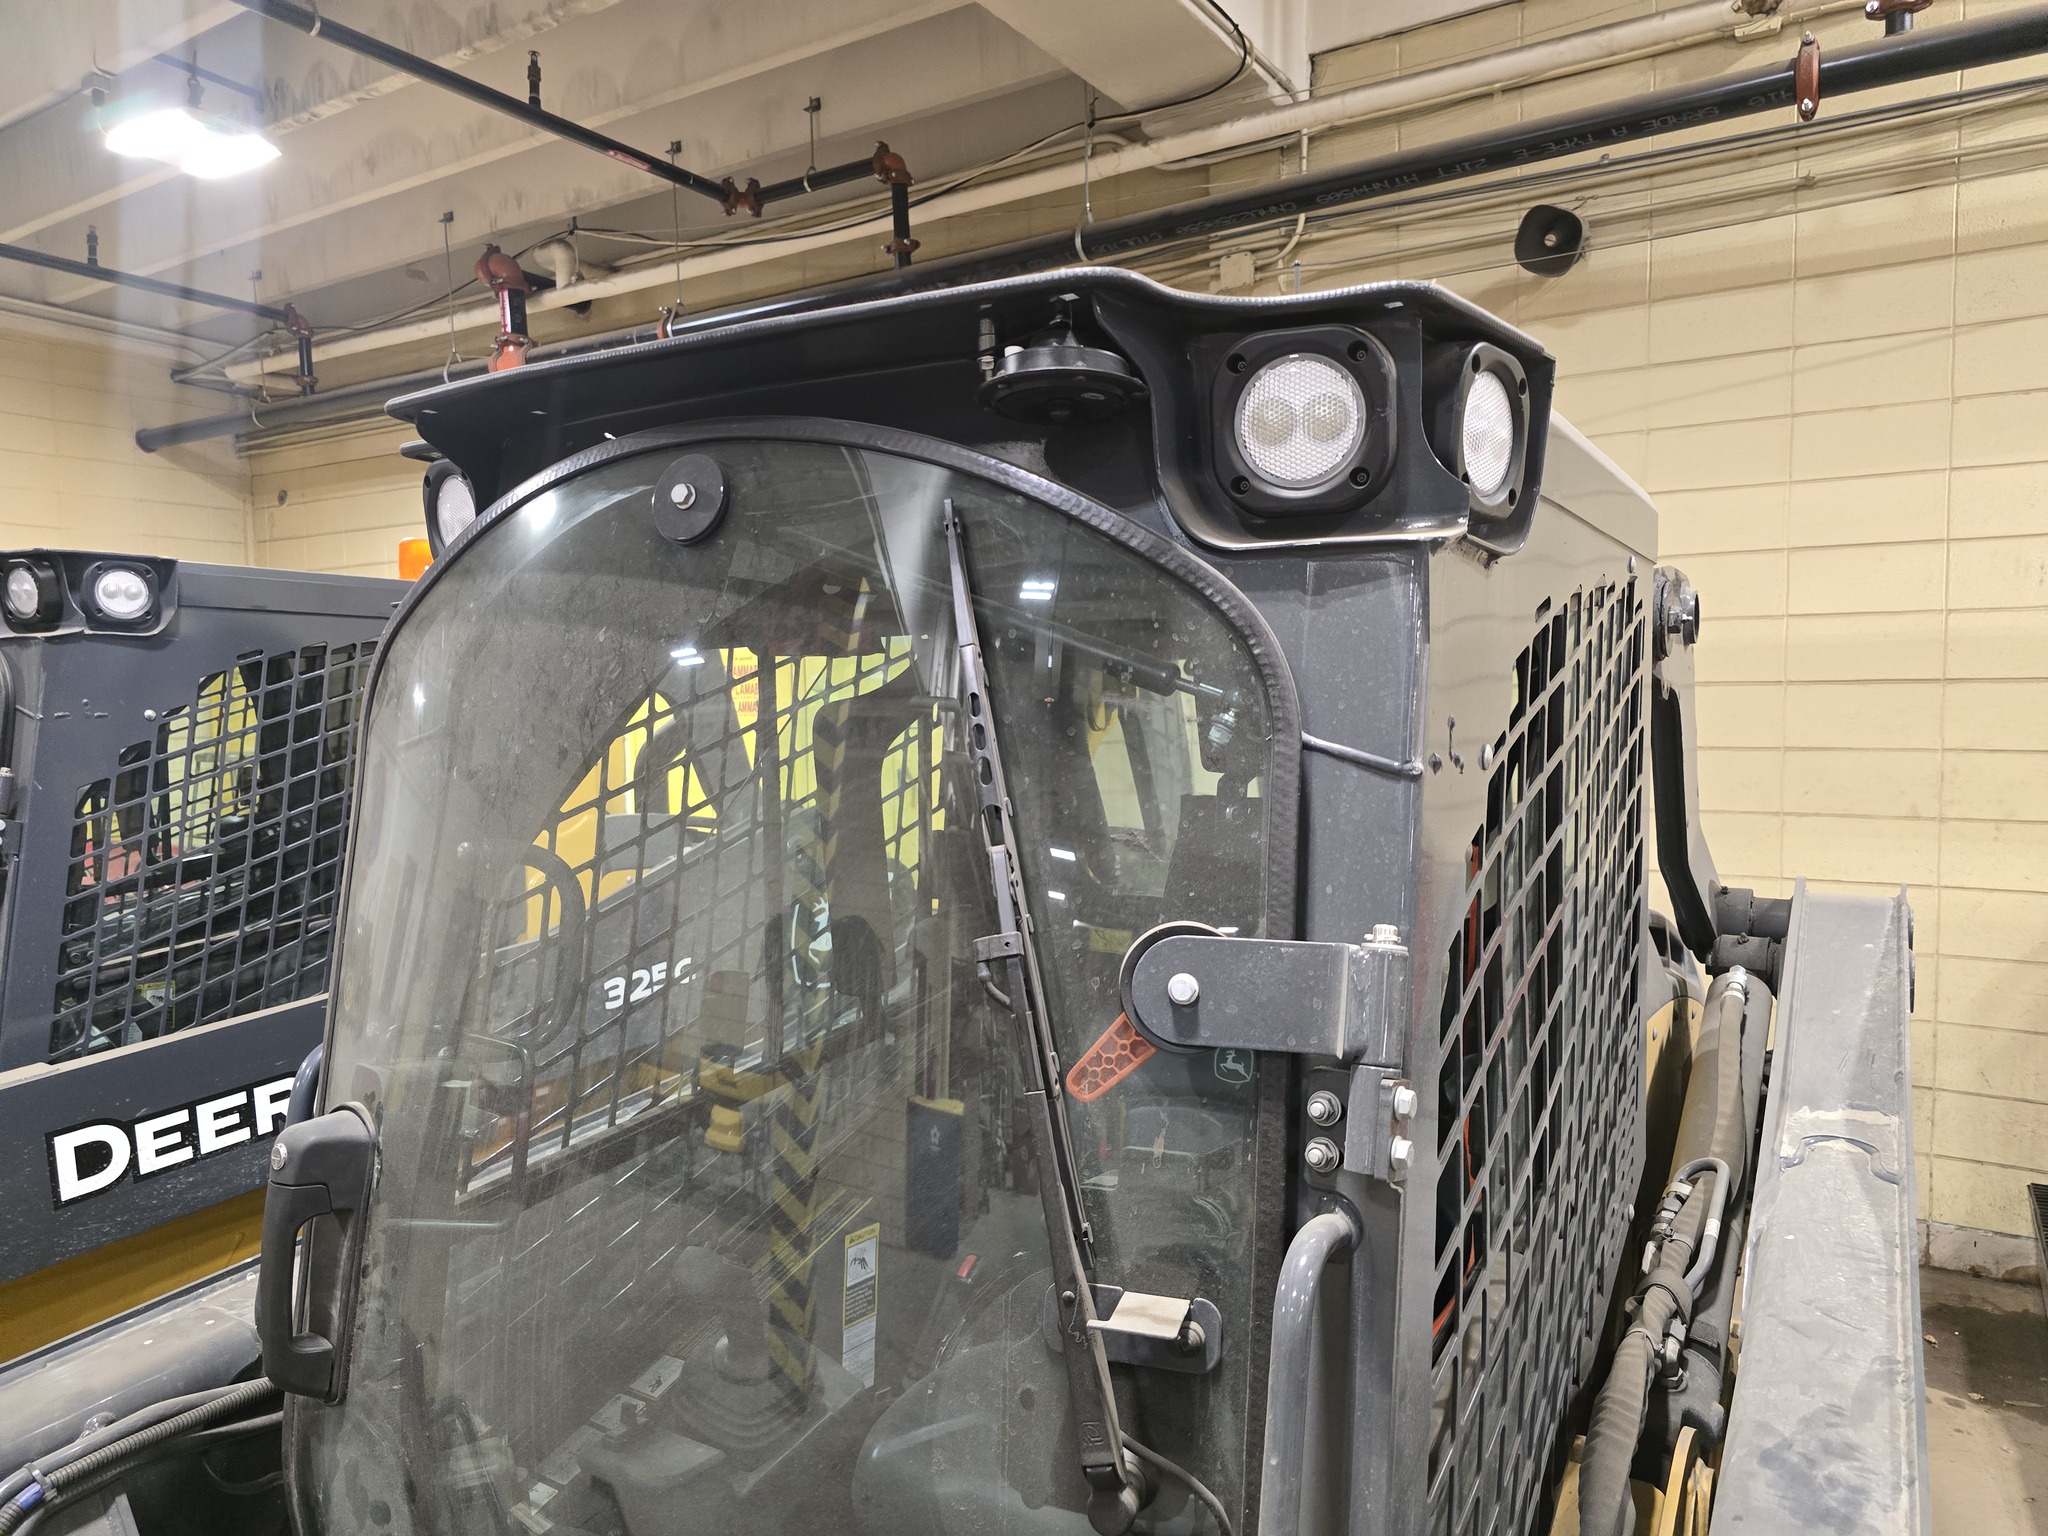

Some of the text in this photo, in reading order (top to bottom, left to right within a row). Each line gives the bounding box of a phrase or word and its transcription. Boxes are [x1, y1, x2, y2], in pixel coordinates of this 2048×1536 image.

[1642, 106, 1719, 133] GRADE
[1611, 125, 1628, 138] A
[1514, 133, 1600, 159] TYPE-E
[1437, 158, 1487, 178] 21FT
